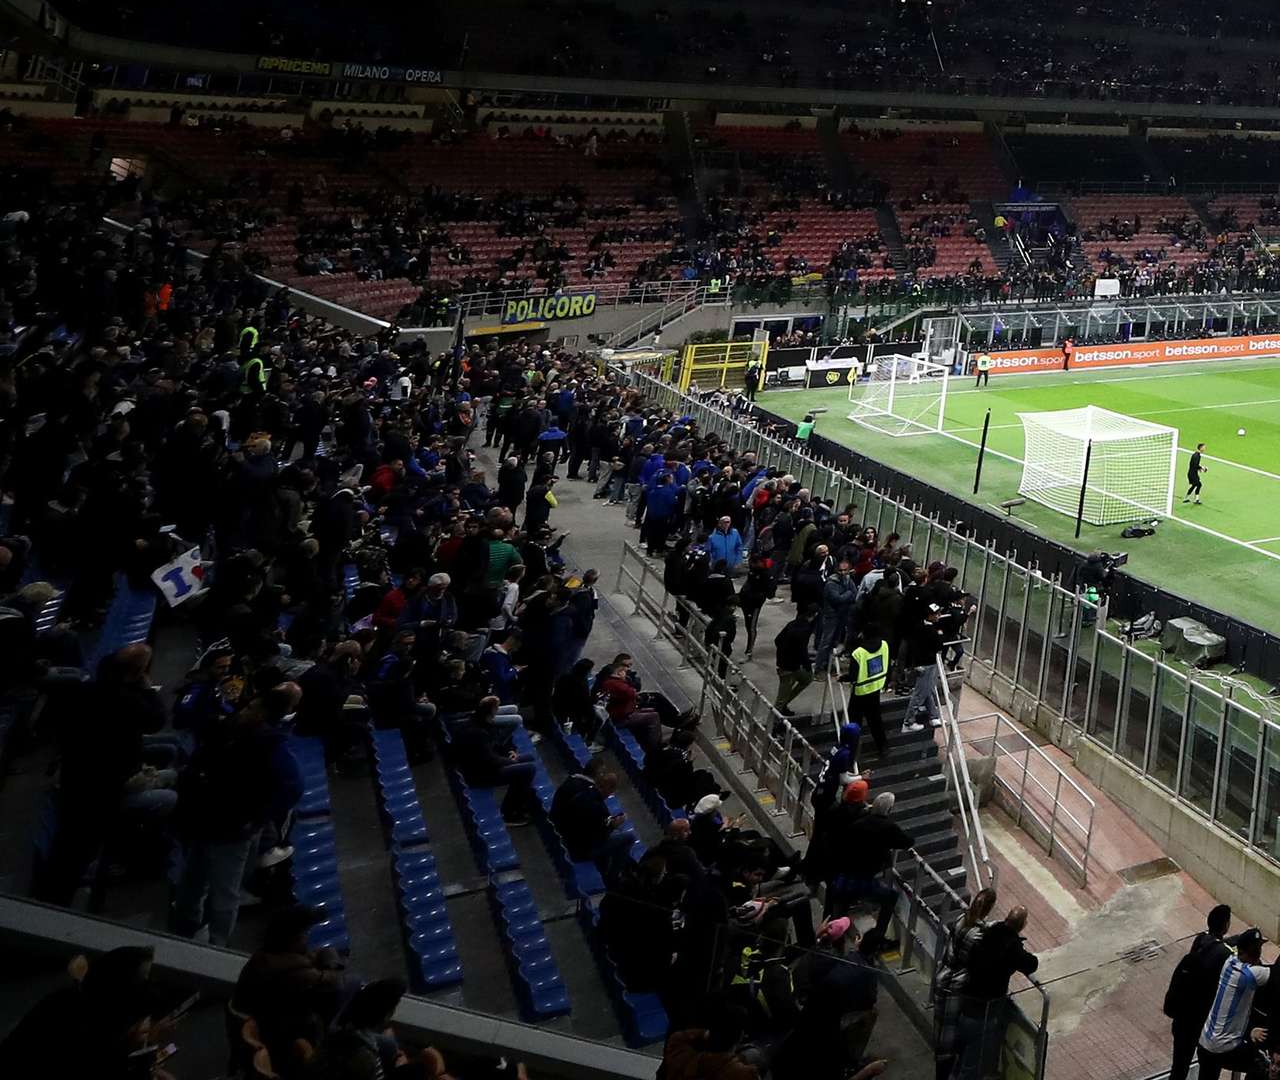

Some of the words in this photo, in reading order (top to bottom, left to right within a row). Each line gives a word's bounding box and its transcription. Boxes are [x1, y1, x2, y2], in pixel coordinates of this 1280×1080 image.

[343, 64, 390, 80] MILANO
[405, 69, 442, 83] OPERA
[504, 294, 596, 322] POLICORO
[1074, 349, 1160, 363] betsson.sport
[1165, 343, 1244, 356] betsson.sport
[979, 354, 1066, 369] etsson.spor
